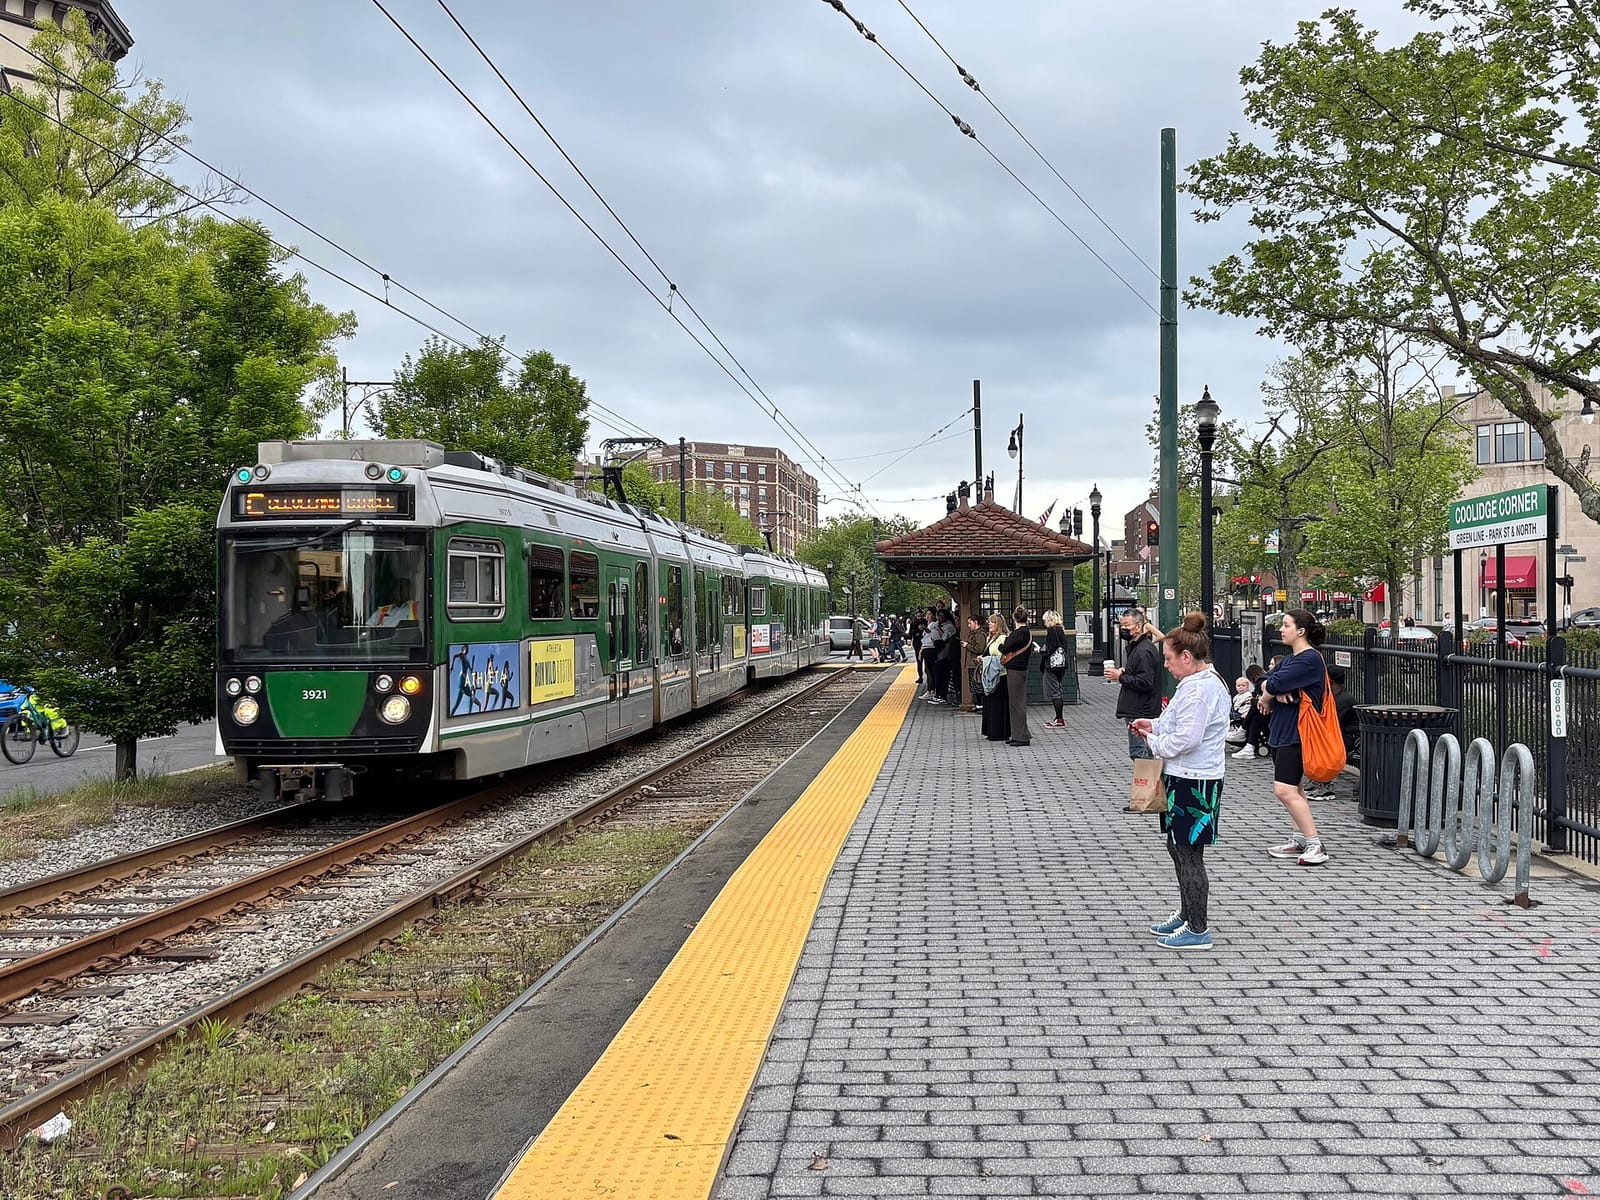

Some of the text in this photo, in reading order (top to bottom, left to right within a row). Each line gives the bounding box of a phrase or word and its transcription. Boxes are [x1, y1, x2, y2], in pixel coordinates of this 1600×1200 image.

[1455, 491, 1538, 525] COOLIDGE CORNER
[1455, 532, 1473, 545] GREEN
[1473, 529, 1485, 543] LINE
[1488, 527, 1503, 541] PARK
[1503, 526, 1511, 539] ST
[1515, 521, 1537, 537] NORTH
[915, 569, 1015, 579] COOLIDGE CORNER
[464, 669, 507, 688] ATHLETA
[302, 690, 327, 700] 3921
